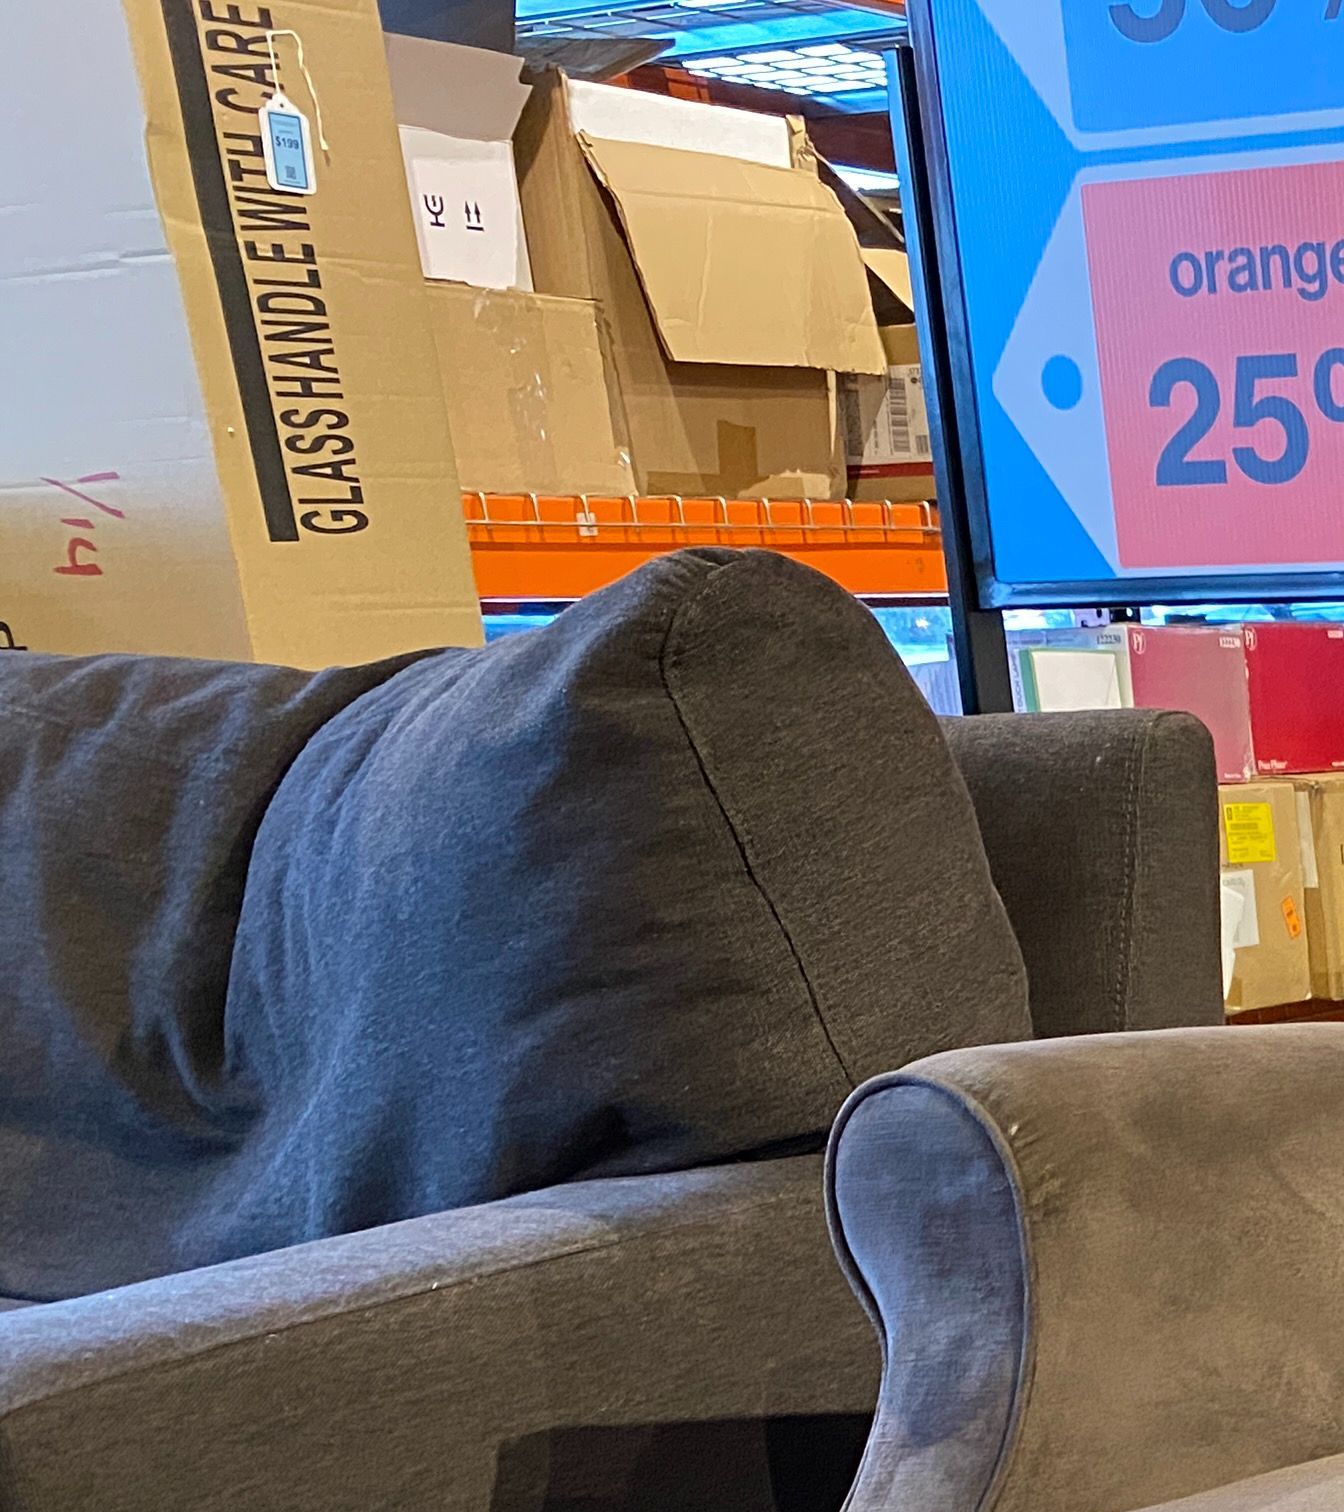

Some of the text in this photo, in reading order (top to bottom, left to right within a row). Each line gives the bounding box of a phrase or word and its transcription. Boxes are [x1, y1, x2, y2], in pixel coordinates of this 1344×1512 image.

[201, 0, 369, 534] GLASS HANDLE WITH CARE
[275, 135, 299, 150] $199
